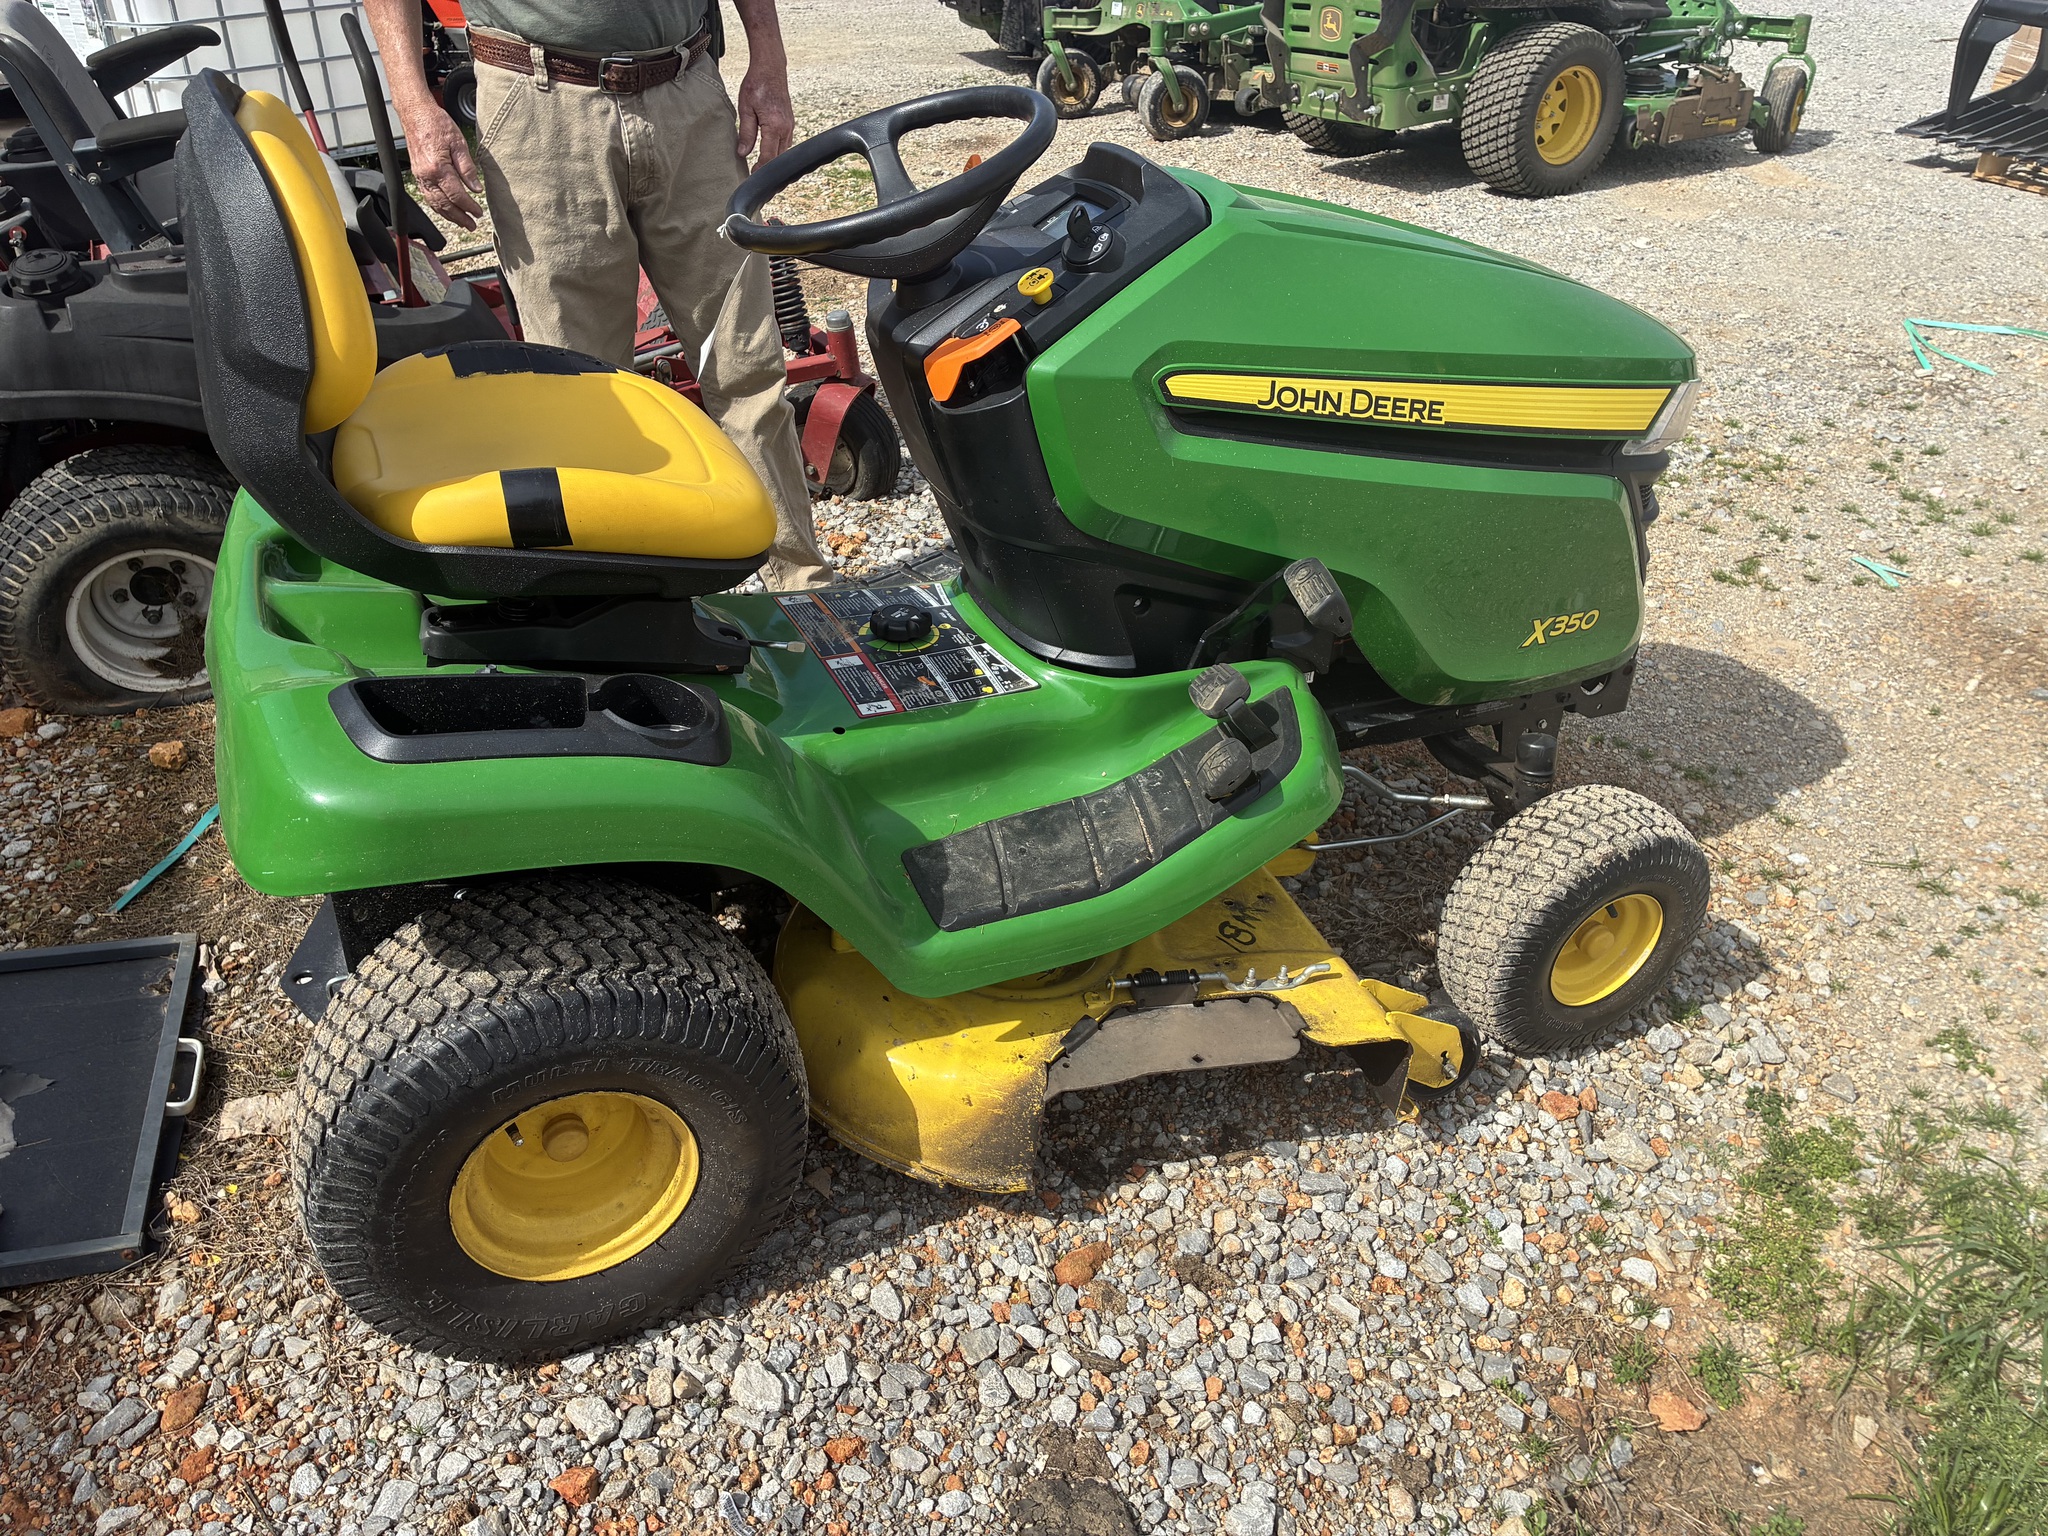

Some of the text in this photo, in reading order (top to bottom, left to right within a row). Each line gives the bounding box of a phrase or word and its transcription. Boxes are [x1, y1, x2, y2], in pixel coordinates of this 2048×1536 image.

[1257, 380, 1446, 422] JOHN DEERE
[1519, 609, 1600, 648] X350
[491, 1058, 610, 1104] MULTI
[627, 1057, 706, 1092] TRAC
[414, 1289, 648, 1339] CARLISLE
